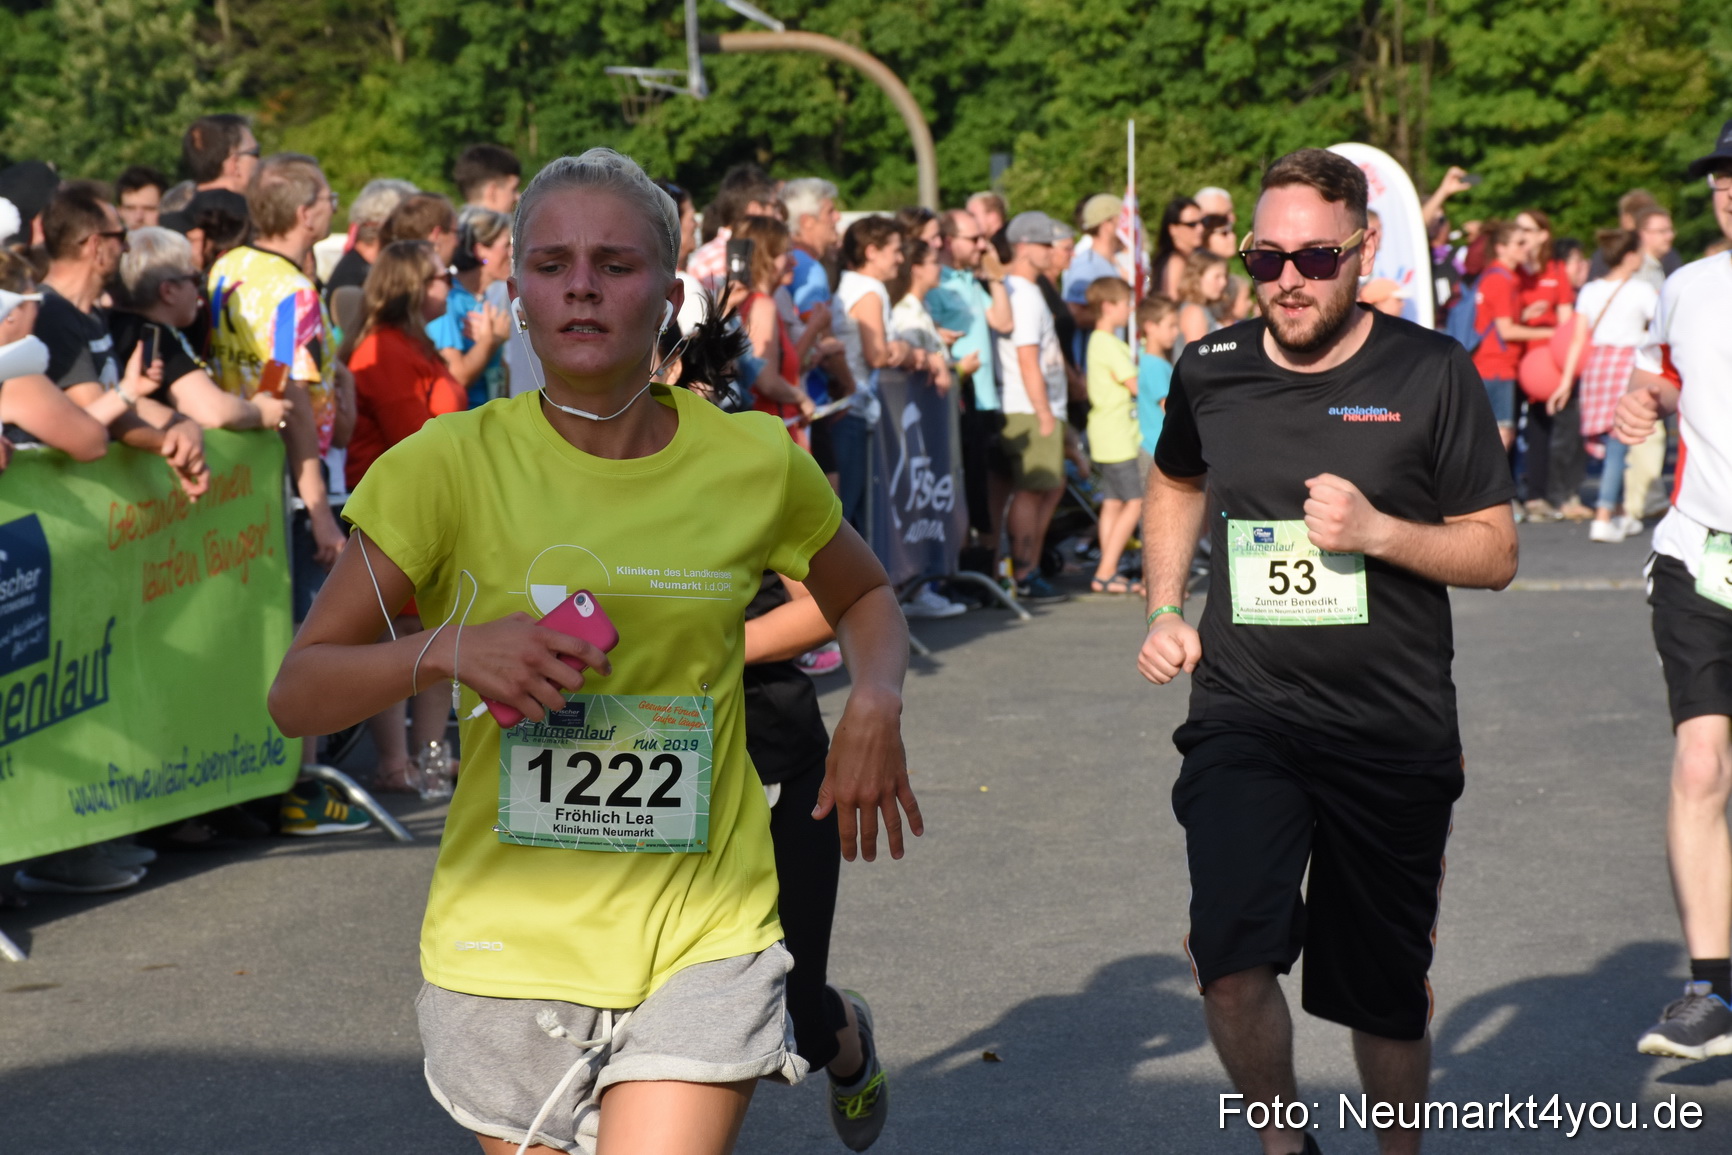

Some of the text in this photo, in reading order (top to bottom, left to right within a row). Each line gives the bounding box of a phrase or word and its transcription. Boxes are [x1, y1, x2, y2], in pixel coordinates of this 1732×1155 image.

[1211, 341, 1237, 353] JAKO
[1328, 405, 1388, 416] autoladen
[1343, 412, 1401, 422] neumarkt
[1246, 541, 1296, 552] firmenlauf
[616, 566, 732, 580] Kliniken des Landkreises
[1268, 559, 1317, 595] 53
[650, 580, 702, 591] Neumarkt
[1255, 597, 1338, 607] Zunner Benedikt
[0, 617, 115, 740] enlauf
[533, 723, 617, 741] firmenlauf
[532, 737, 569, 745] neumarkt
[662, 739, 699, 751] 2019
[527, 748, 683, 808] 1222
[555, 807, 654, 825] Fröhlich Lea
[552, 824, 655, 838] Klinikum Neumarkt
[455, 941, 504, 951] SPIRO
